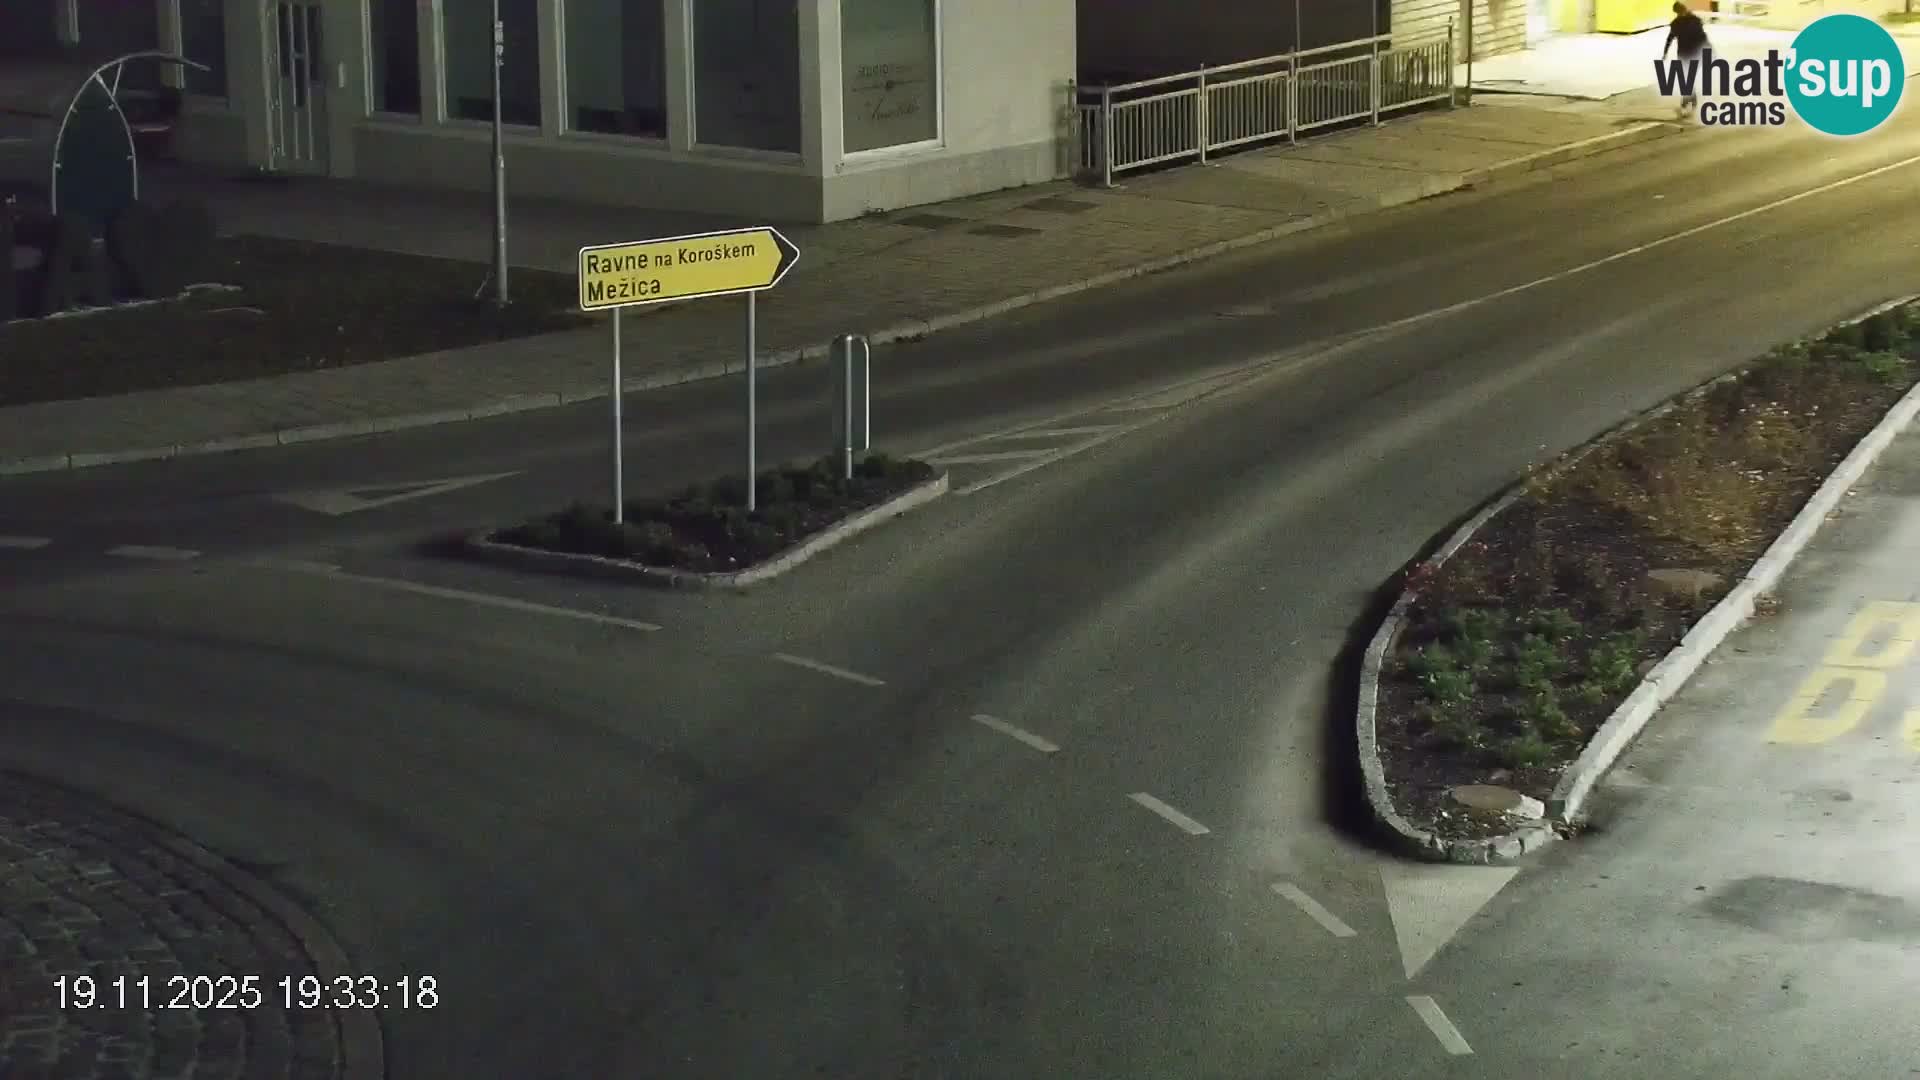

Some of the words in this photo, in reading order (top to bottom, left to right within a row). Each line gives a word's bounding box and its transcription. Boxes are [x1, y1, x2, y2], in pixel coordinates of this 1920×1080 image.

[587, 254, 648, 274] Ravne
[655, 255, 673, 267] na
[678, 244, 755, 264] Koroškem
[588, 276, 661, 301] Mežica
